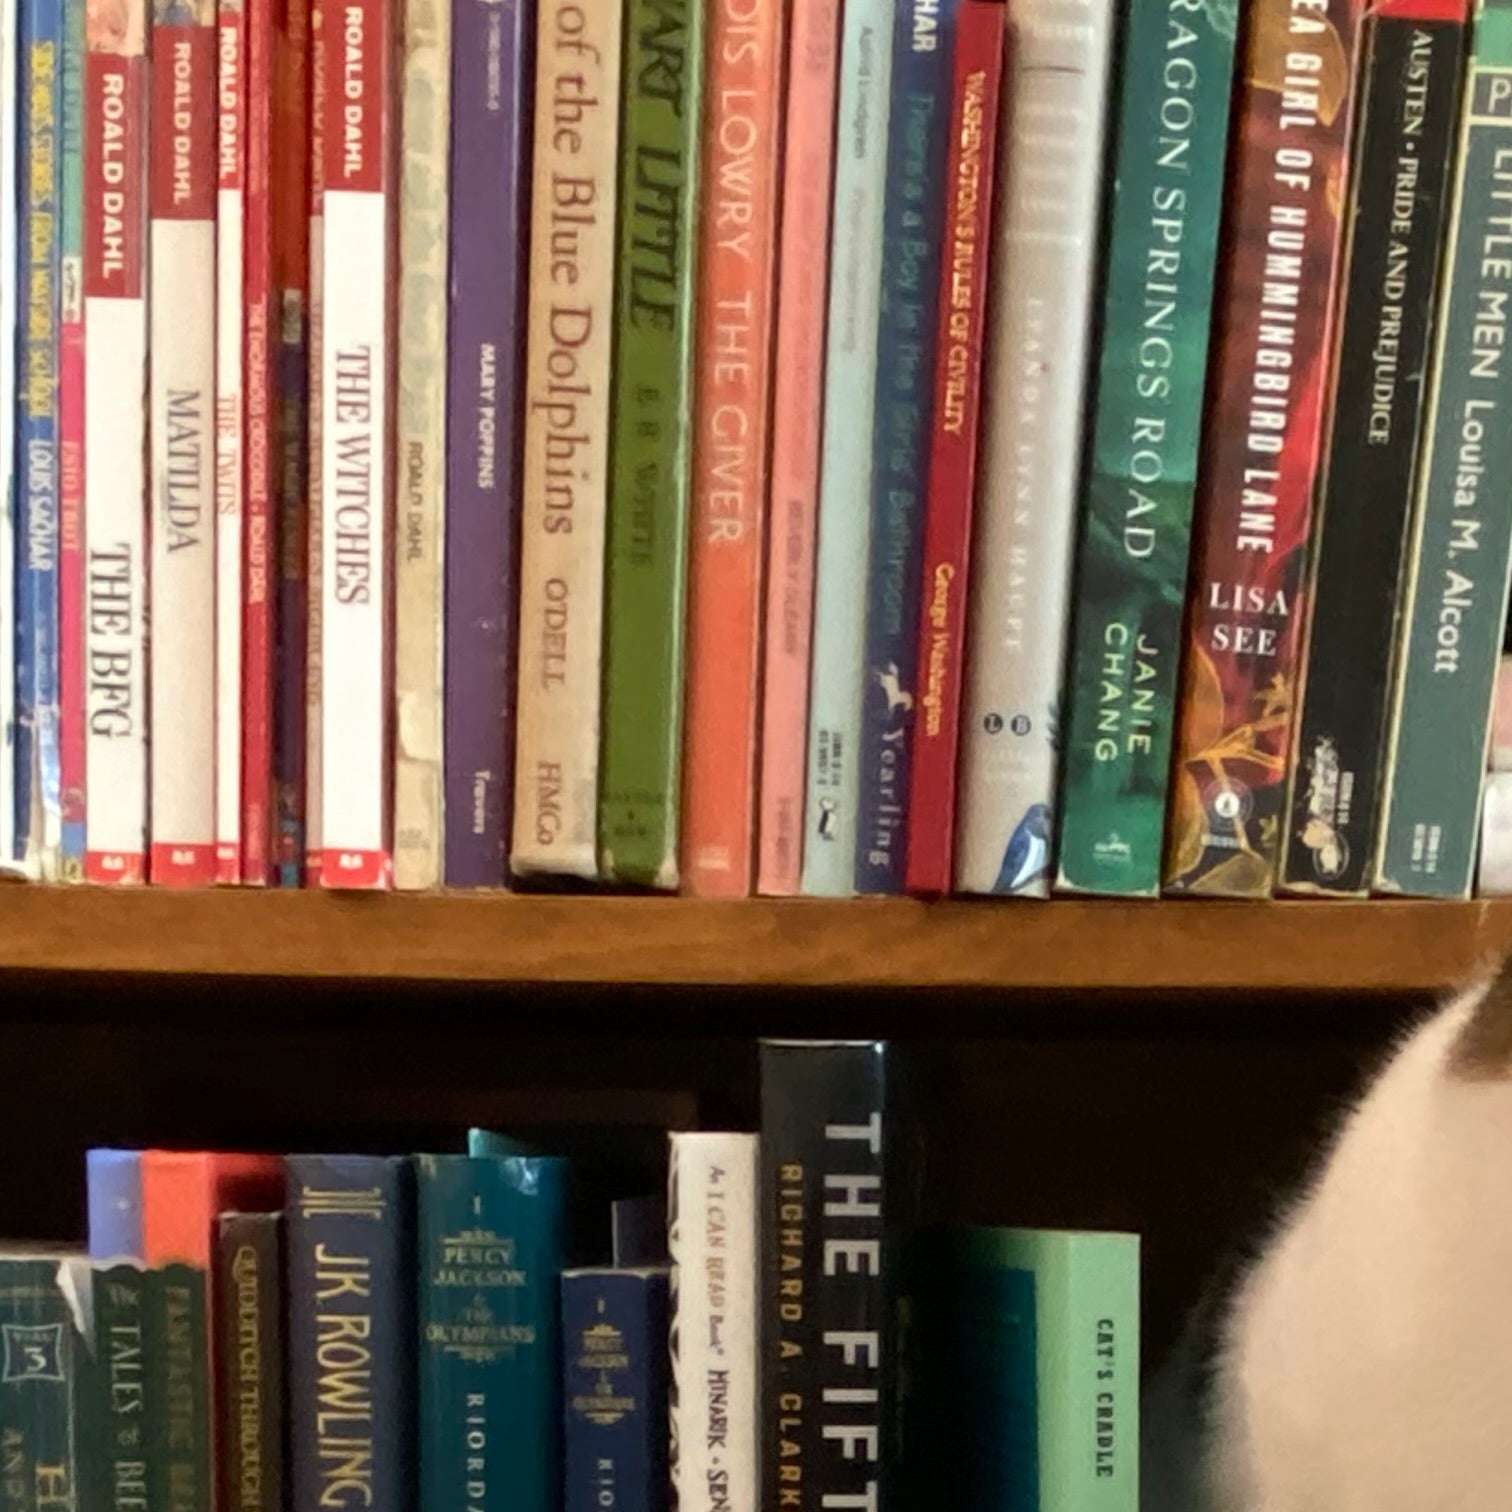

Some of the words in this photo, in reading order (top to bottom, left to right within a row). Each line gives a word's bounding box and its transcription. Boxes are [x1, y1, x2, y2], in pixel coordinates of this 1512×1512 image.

[219, 26, 237, 109] ROALD
[343, 6, 365, 101] ROALD
[554, 5, 600, 66] of
[1404, 28, 1434, 137] AUSTEN
[102, 73, 125, 185] ROALD
[173, 41, 193, 131] ROALD
[551, 76, 598, 156] the
[1279, 52, 1324, 130] GIRL
[173, 136, 193, 205] DAHL
[219, 113, 237, 180] DAHL
[343, 106, 365, 179] DAHL
[717, 90, 759, 255] LOWRY
[955, 71, 988, 240] WASHINGTON'S
[1273, 148, 1313, 193] OF
[102, 192, 125, 279] DAHL
[548, 176, 596, 287] Blue
[630, 147, 682, 333] LITTLE
[1391, 156, 1420, 236] PRIDE
[950, 241, 976, 311] RULES
[1135, 186, 1187, 401] SPRINGS
[1385, 242, 1413, 301] AND
[713, 290, 750, 384] THE
[1246, 206, 1308, 461] HUMMINGBIRD
[1367, 304, 1405, 447] PREJUDICE
[1469, 290, 1511, 380] MEN
[334, 345, 373, 425] THE
[532, 305, 593, 536] Dolphins
[943, 345, 969, 435] CIVILITY
[166, 389, 200, 553] MATILDA
[707, 407, 749, 543] GIVER
[1123, 415, 1166, 560] ROAD
[1452, 399, 1497, 509] Louisa
[334, 434, 373, 605] WITCHES
[405, 512, 424, 562] DAHL
[1237, 471, 1283, 554] LANE
[90, 543, 132, 637] THE
[1208, 582, 1289, 617] LISA
[1431, 570, 1475, 674] Alcott
[1211, 624, 1278, 657] SEE
[90, 650, 132, 740] BFG
[1094, 622, 1127, 762] CHANG
[1126, 633, 1158, 756] JANIE
[869, 728, 907, 867] Yearling
[822, 1111, 882, 1277] THE
[314, 1243, 370, 1299] JK
[778, 1163, 804, 1323] RICHARD
[231, 1245, 260, 1382] QUIDDITCH
[1095, 1317, 1116, 1383] CAT'S
[110, 1323, 145, 1414] TALES
[315, 1313, 373, 1511] ROWLING
[238, 1386, 263, 1507] THROUGH
[1095, 1390, 1116, 1480] CRADLE
